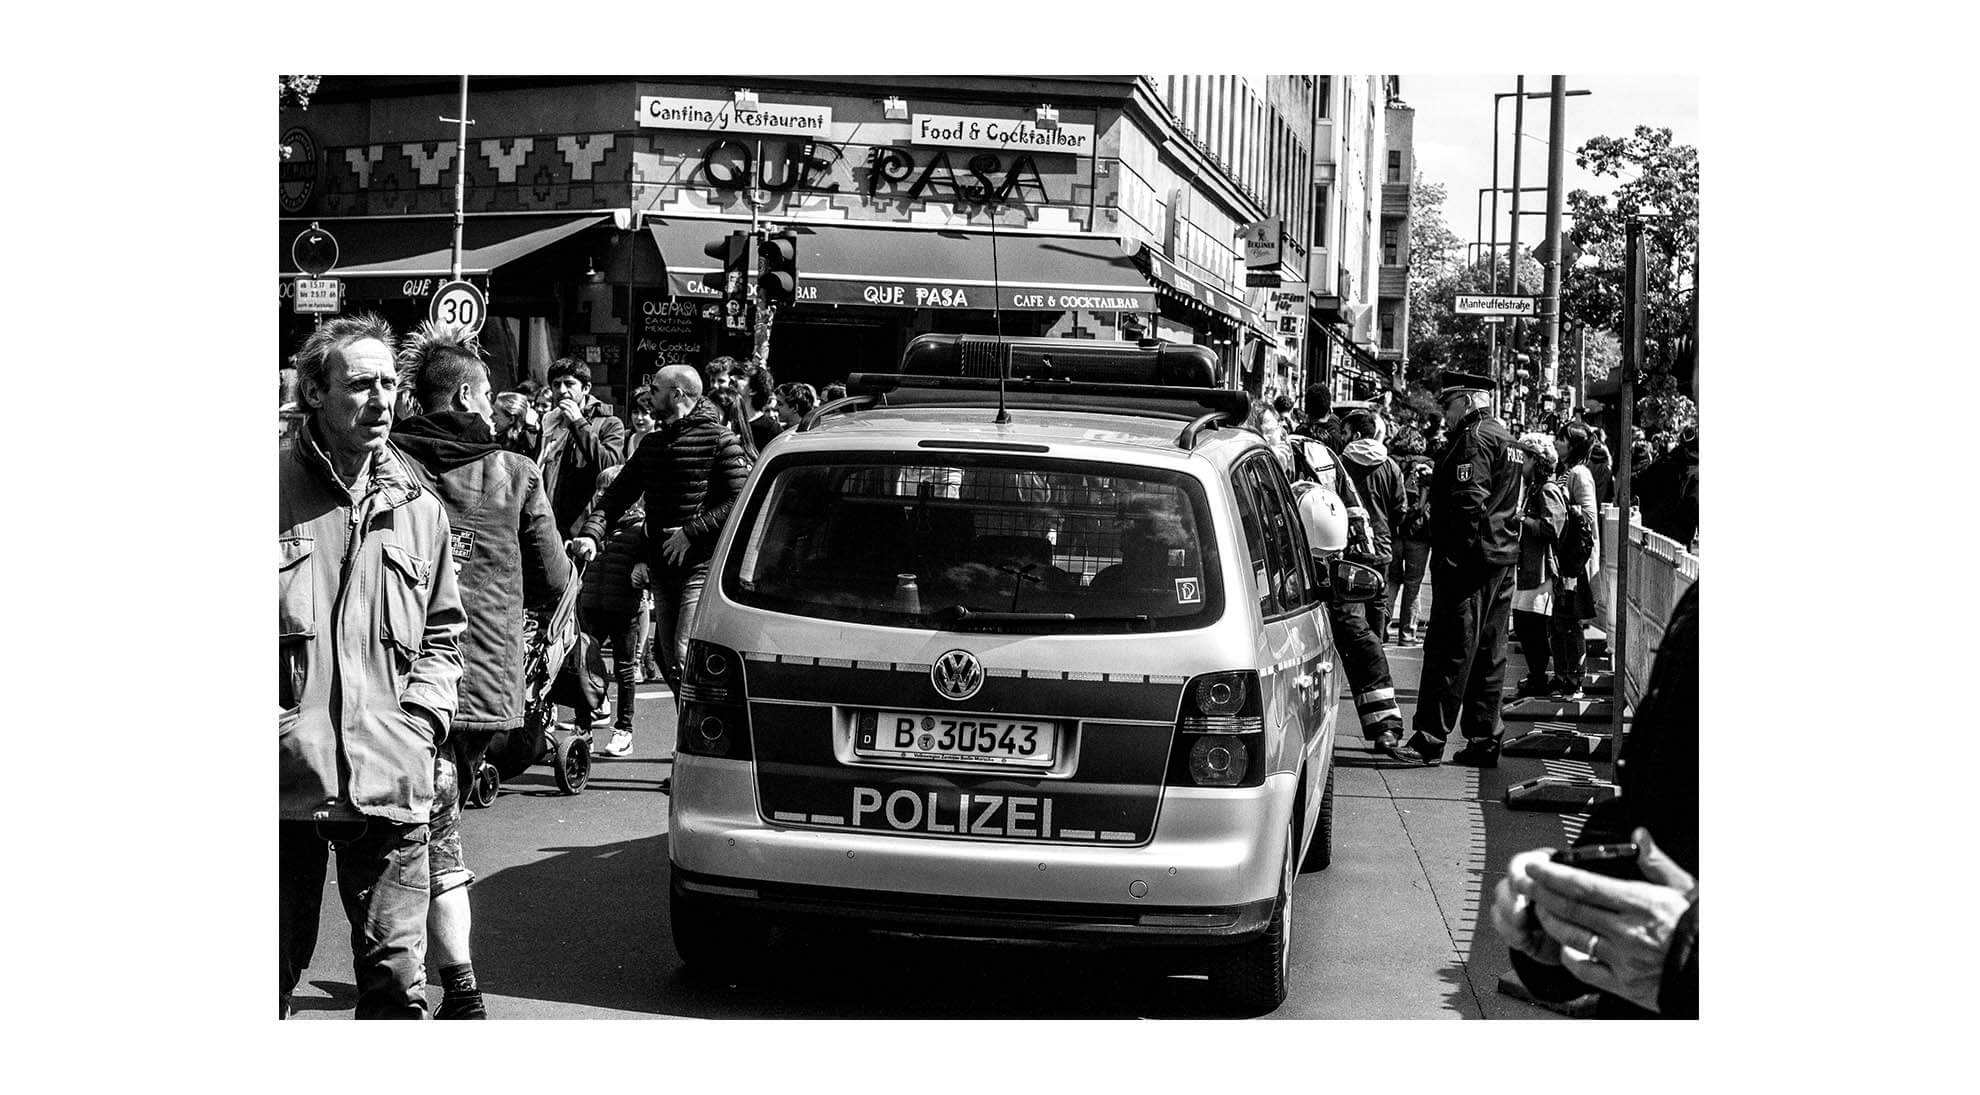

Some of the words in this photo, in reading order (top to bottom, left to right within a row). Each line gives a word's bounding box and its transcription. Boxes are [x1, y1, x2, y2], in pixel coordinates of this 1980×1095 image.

[649, 100, 713, 123] Cantina
[719, 111, 729, 130] y
[734, 110, 824, 129] Restaurant
[920, 119, 964, 140] Food
[968, 122, 981, 141] &
[986, 123, 1087, 147] Cocktailbar
[702, 138, 843, 192] QUE
[868, 145, 1050, 205] PASA
[402, 279, 432, 297] QUE
[863, 285, 905, 305] QUE
[915, 287, 968, 307] PASA
[443, 298, 474, 325] 30
[642, 301, 669, 316] QUE
[1013, 294, 1044, 308] CAFE
[1048, 295, 1057, 308] &
[1060, 295, 1139, 309] COCKTAILBAR
[1459, 297, 1531, 313] Manteuffelstraße
[863, 734, 871, 744] D
[895, 717, 915, 748] B
[938, 719, 1038, 755] 30543
[852, 786, 1053, 838] POLIZEI
